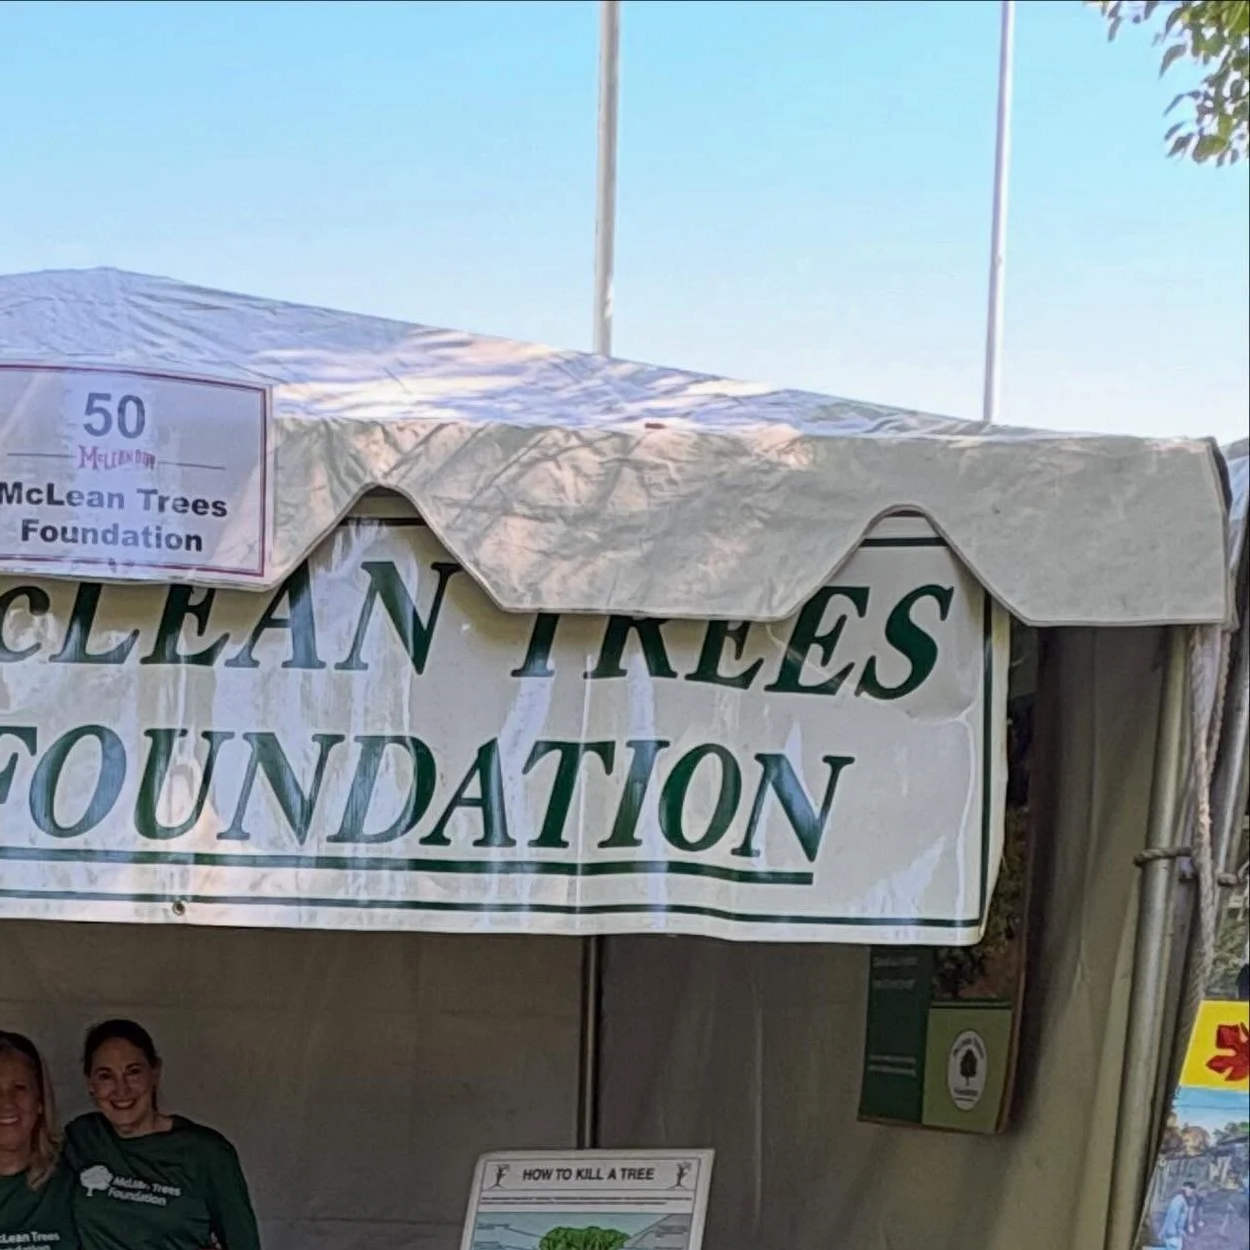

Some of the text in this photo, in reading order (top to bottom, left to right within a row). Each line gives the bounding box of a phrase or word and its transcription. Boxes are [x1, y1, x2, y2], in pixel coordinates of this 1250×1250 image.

[82, 391, 146, 439] 50
[136, 487, 228, 518] Trees
[20, 519, 203, 552] Foundation
[522, 1167, 656, 1181] HOW TO KILL A TREE
[151, 1183, 182, 1197] Trees
[30, 1231, 60, 1242] Trees
